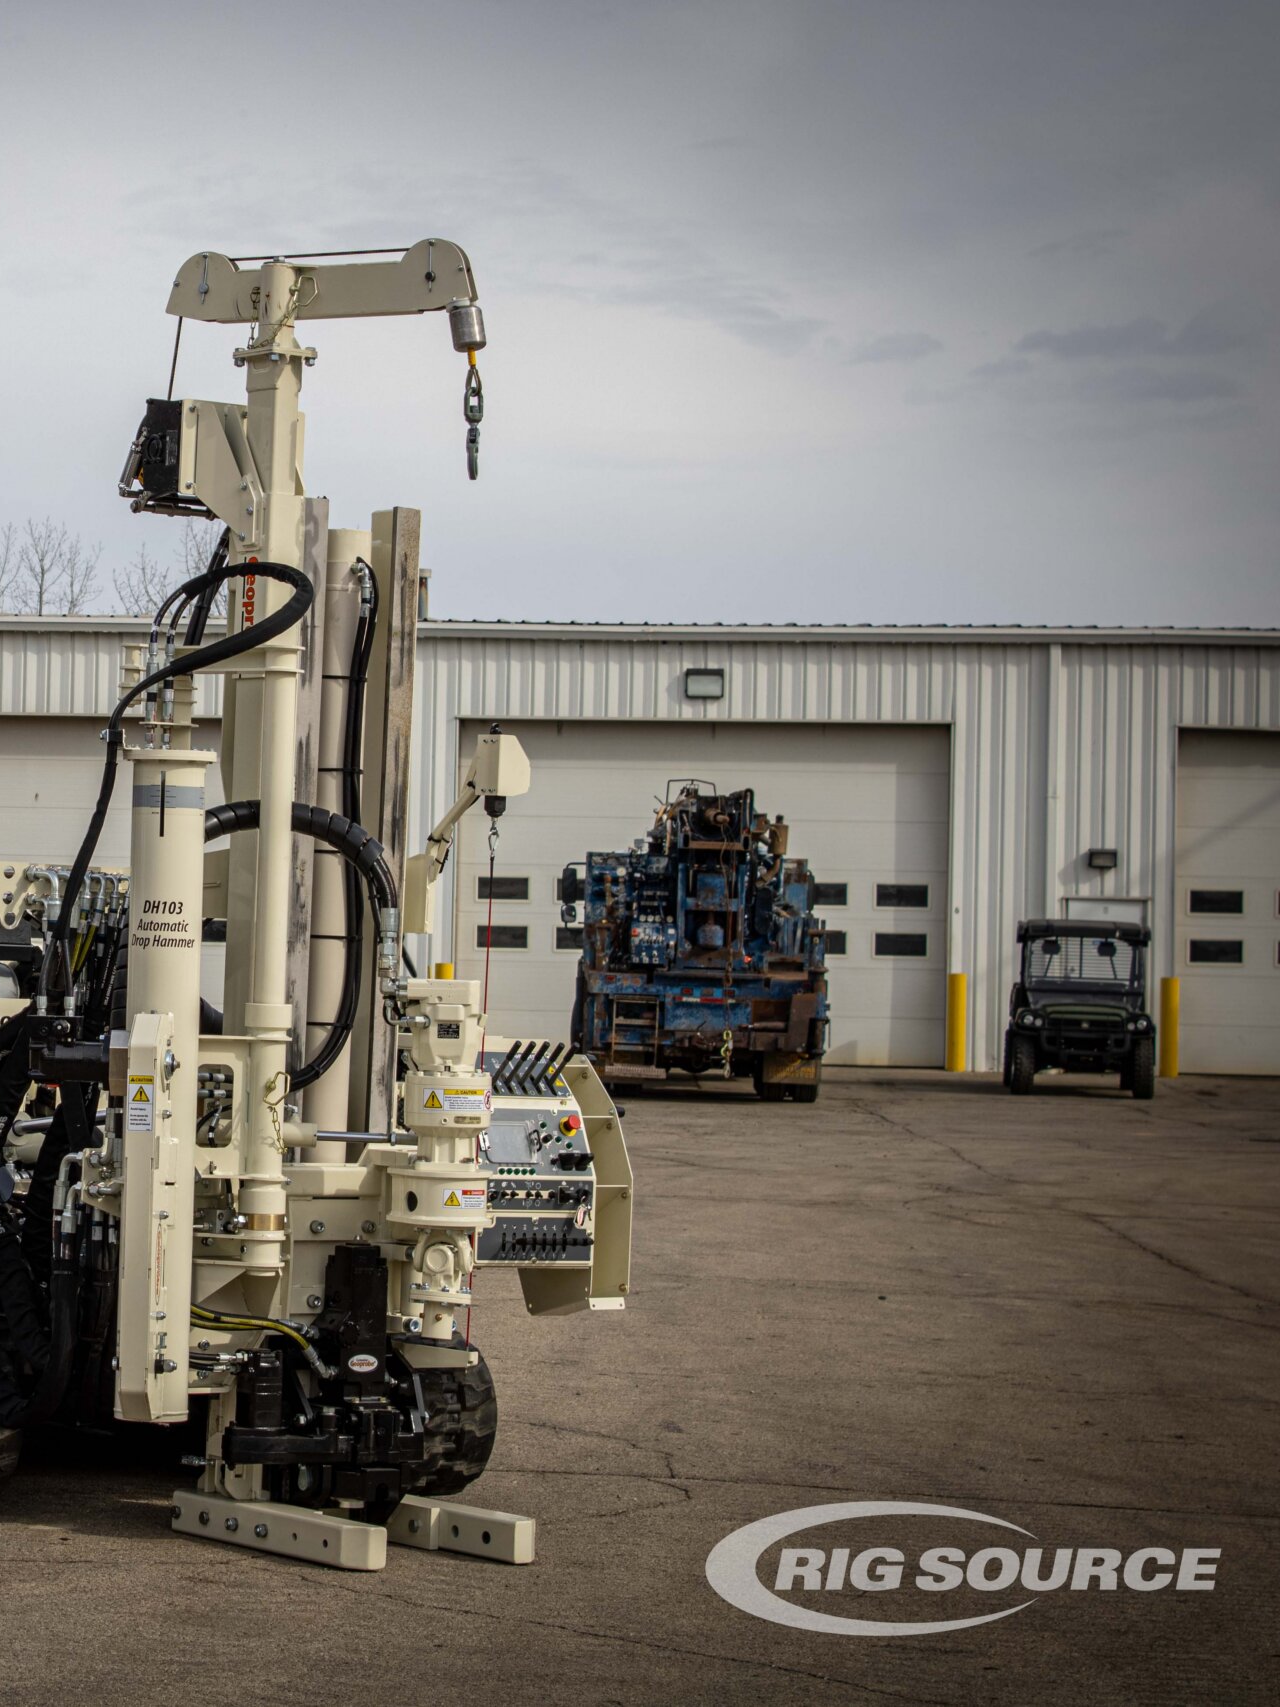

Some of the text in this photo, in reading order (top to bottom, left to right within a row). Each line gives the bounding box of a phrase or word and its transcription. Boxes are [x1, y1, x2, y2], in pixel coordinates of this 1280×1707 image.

[242, 556, 258, 630] eopr
[143, 900, 183, 915] DH103
[137, 918, 189, 933] Automatic
[131, 934, 195, 950] Drop Hammer
